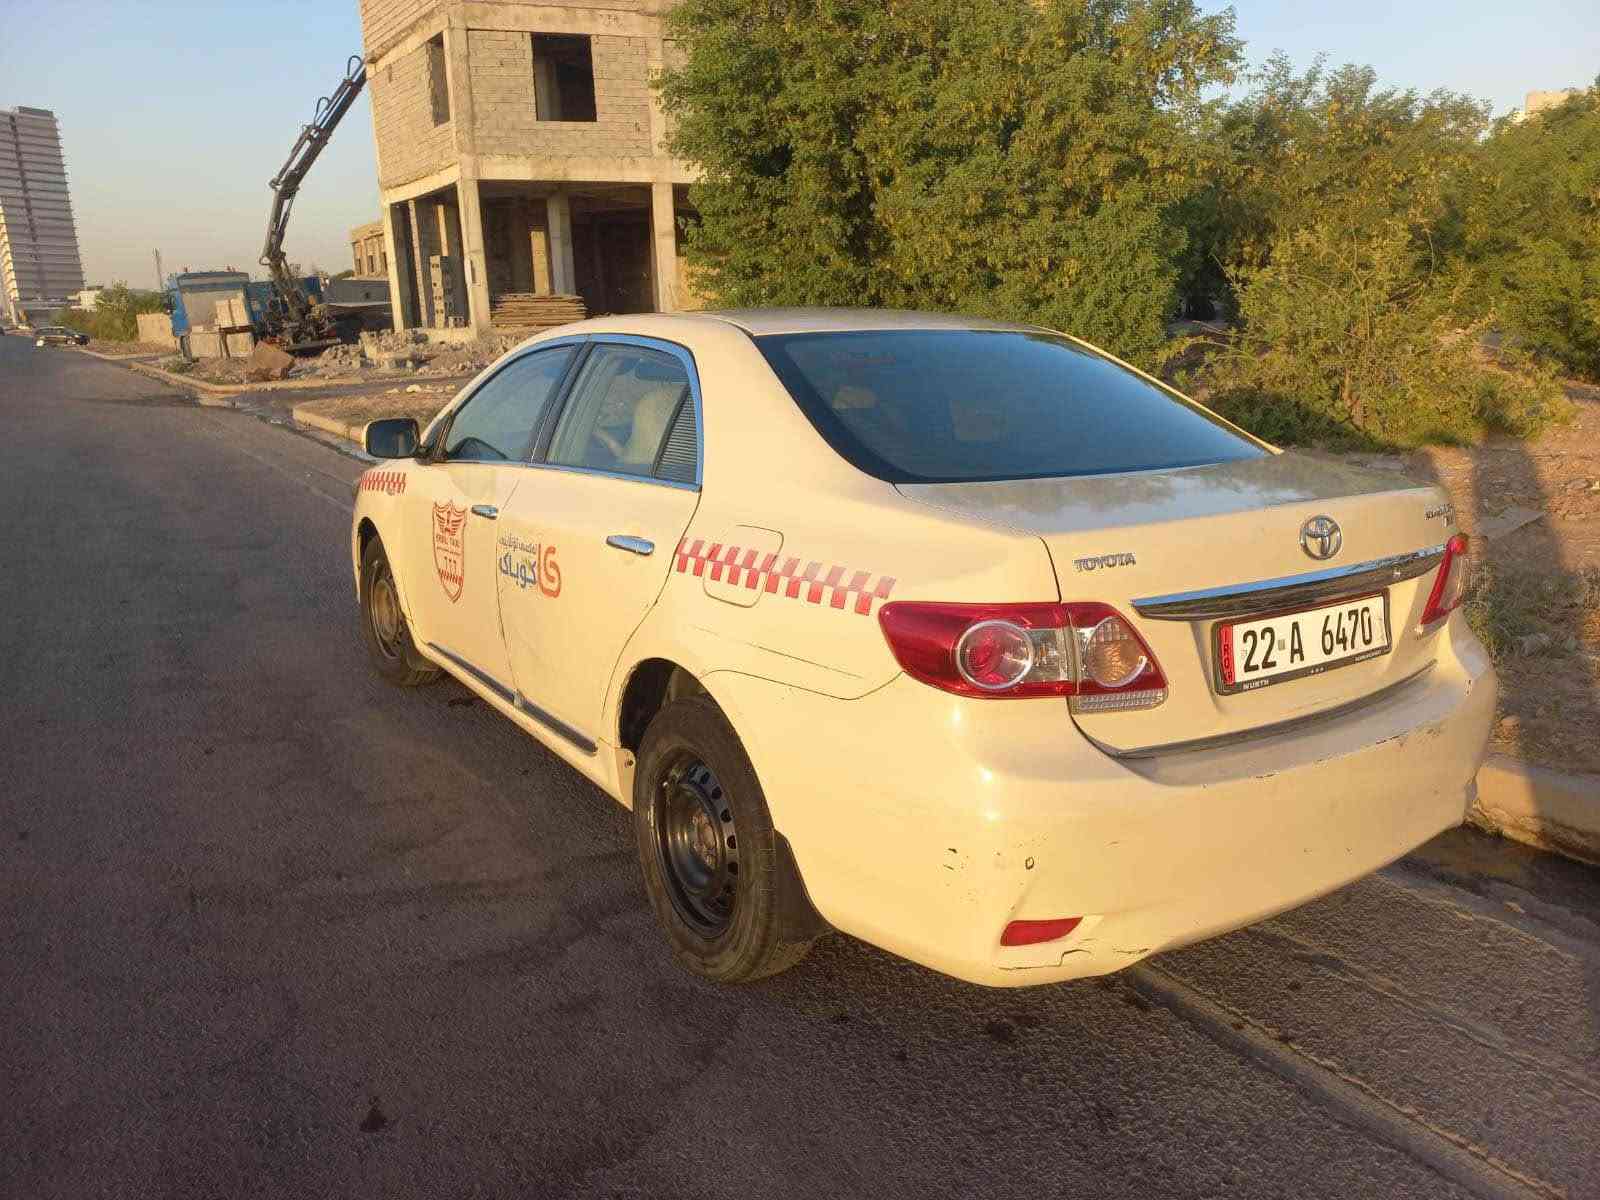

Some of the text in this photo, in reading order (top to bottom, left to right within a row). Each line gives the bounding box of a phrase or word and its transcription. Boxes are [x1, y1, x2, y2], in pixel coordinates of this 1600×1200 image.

[1072, 552, 1136, 572] TOYOTA
[1242, 606, 1374, 673] 22 A 6470
